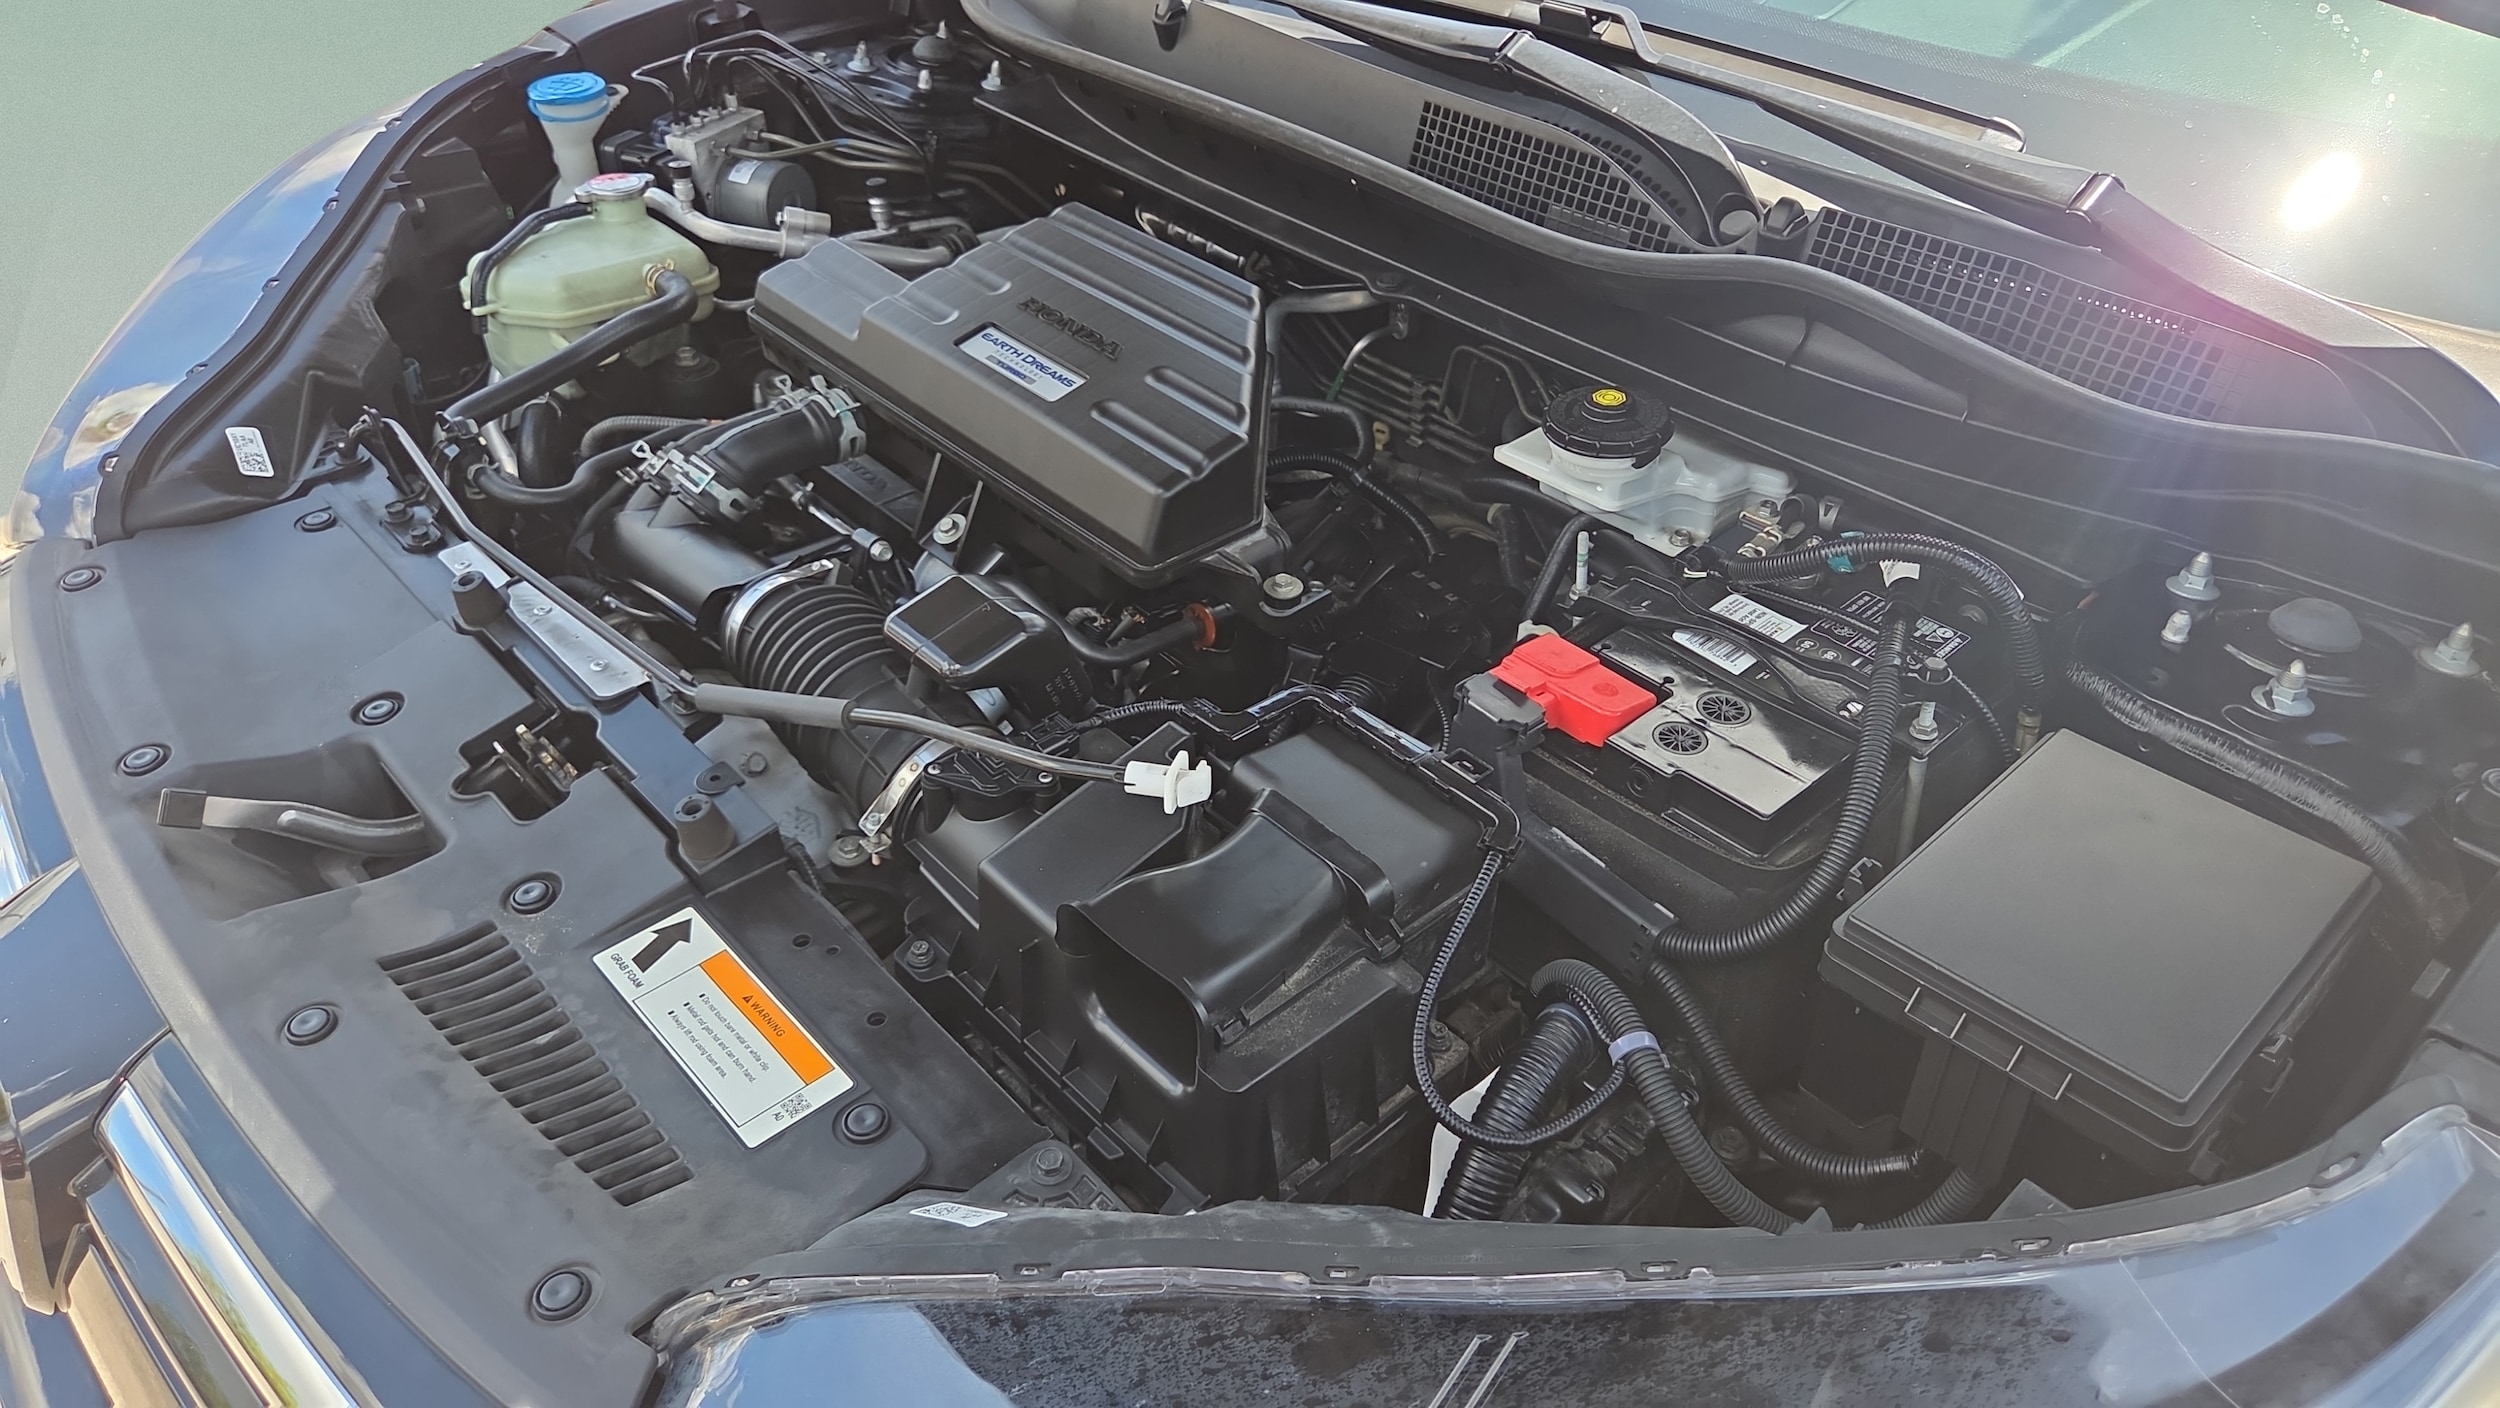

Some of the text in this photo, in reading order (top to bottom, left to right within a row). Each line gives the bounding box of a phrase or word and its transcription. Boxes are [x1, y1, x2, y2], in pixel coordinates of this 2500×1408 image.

[1017, 297, 1123, 360] HONDA
[981, 333, 1077, 388] EARTH DREAMS
[996, 360, 1027, 380] TURBO
[610, 953, 645, 989] GRAB FOAM
[686, 1005, 701, 1019] Metal
[750, 1001, 786, 1037] WARNING
[696, 1017, 708, 1027] rod
[701, 996, 711, 1006] Do
[707, 1003, 718, 1013] not
[714, 1010, 728, 1024] touch
[724, 1021, 737, 1034] bare
[733, 1031, 748, 1045] metal
[748, 1049, 762, 1063] white
[701, 1025, 715, 1036] gets
[670, 1014, 687, 1031] Always
[688, 1034, 700, 1044] rod
[694, 1042, 709, 1056] using
[705, 1053, 718, 1067] foam
[711, 1033, 722, 1043] hot
[717, 1041, 730, 1051] and
[725, 1049, 736, 1060] can
[732, 1057, 745, 1071] burn
